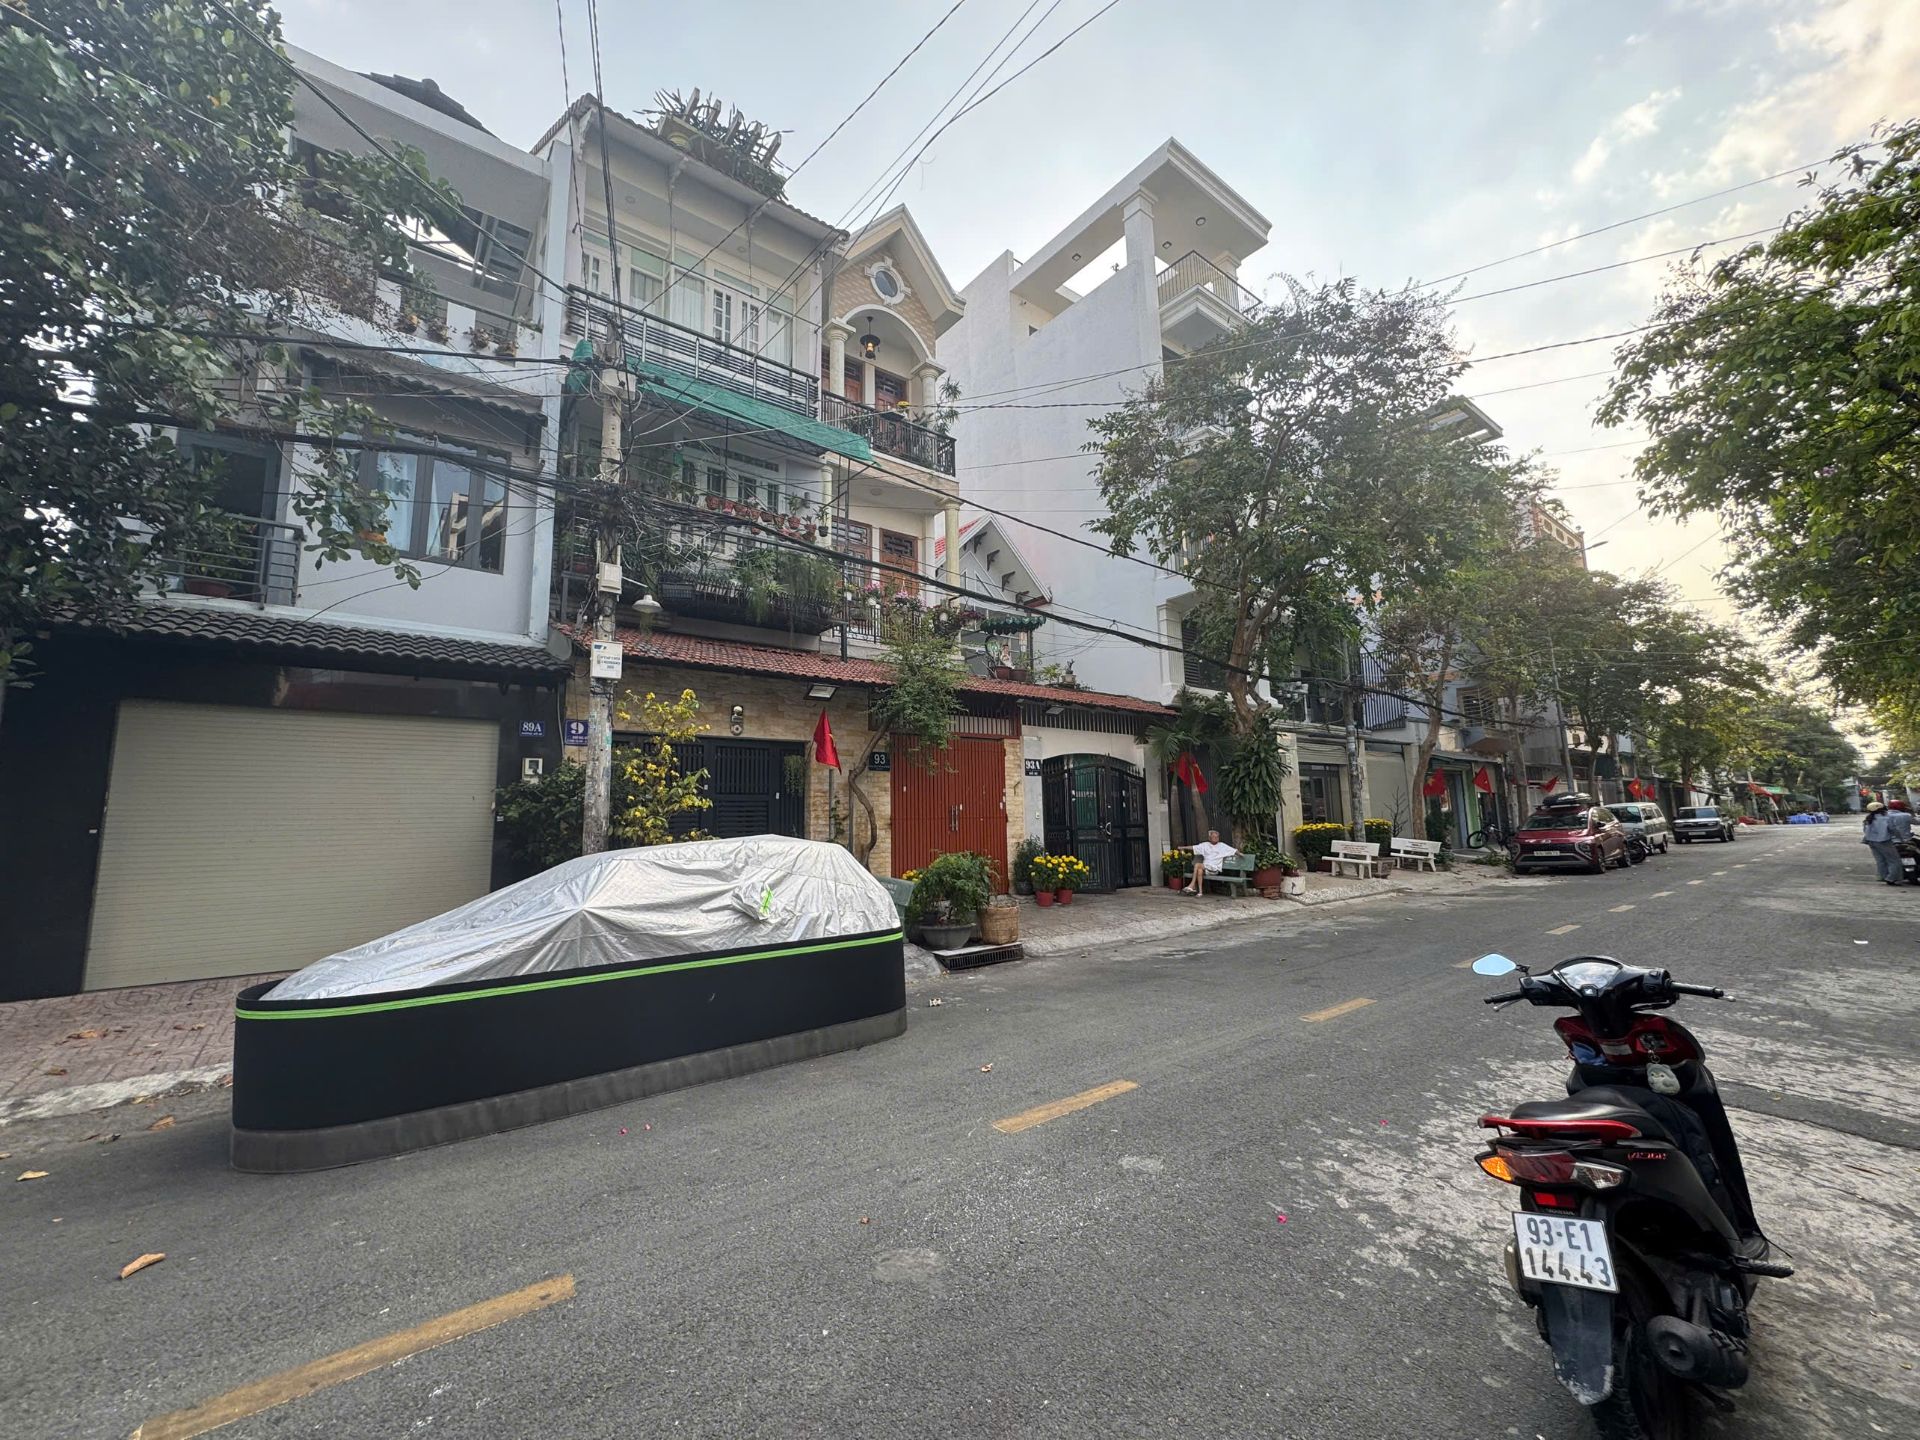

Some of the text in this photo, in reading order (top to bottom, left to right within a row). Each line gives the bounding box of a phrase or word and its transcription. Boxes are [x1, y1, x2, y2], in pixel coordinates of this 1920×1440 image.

[522, 721, 542, 732] 89A
[874, 753, 886, 765] 93
[1025, 760, 1041, 770] 93A
[1526, 1217, 1593, 1252] 93-E1
[1525, 1247, 1611, 1287] 144.43
